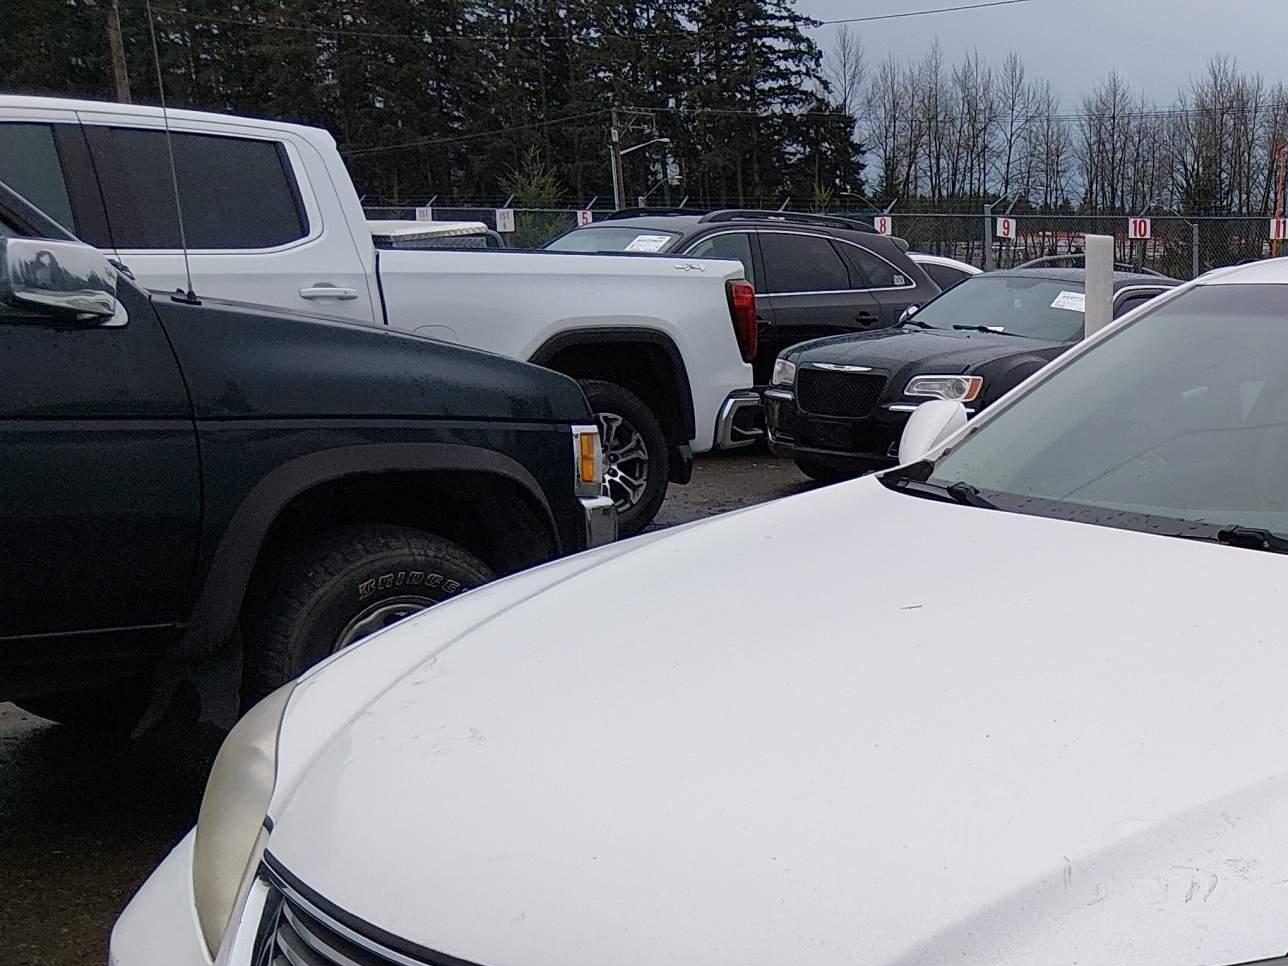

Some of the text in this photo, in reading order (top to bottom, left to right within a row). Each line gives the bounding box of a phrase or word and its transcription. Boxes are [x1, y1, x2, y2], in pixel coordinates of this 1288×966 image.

[879, 217, 887, 235] 8
[1002, 219, 1010, 237] 9
[1132, 219, 1148, 238] 10
[1274, 219, 1287, 239] 11
